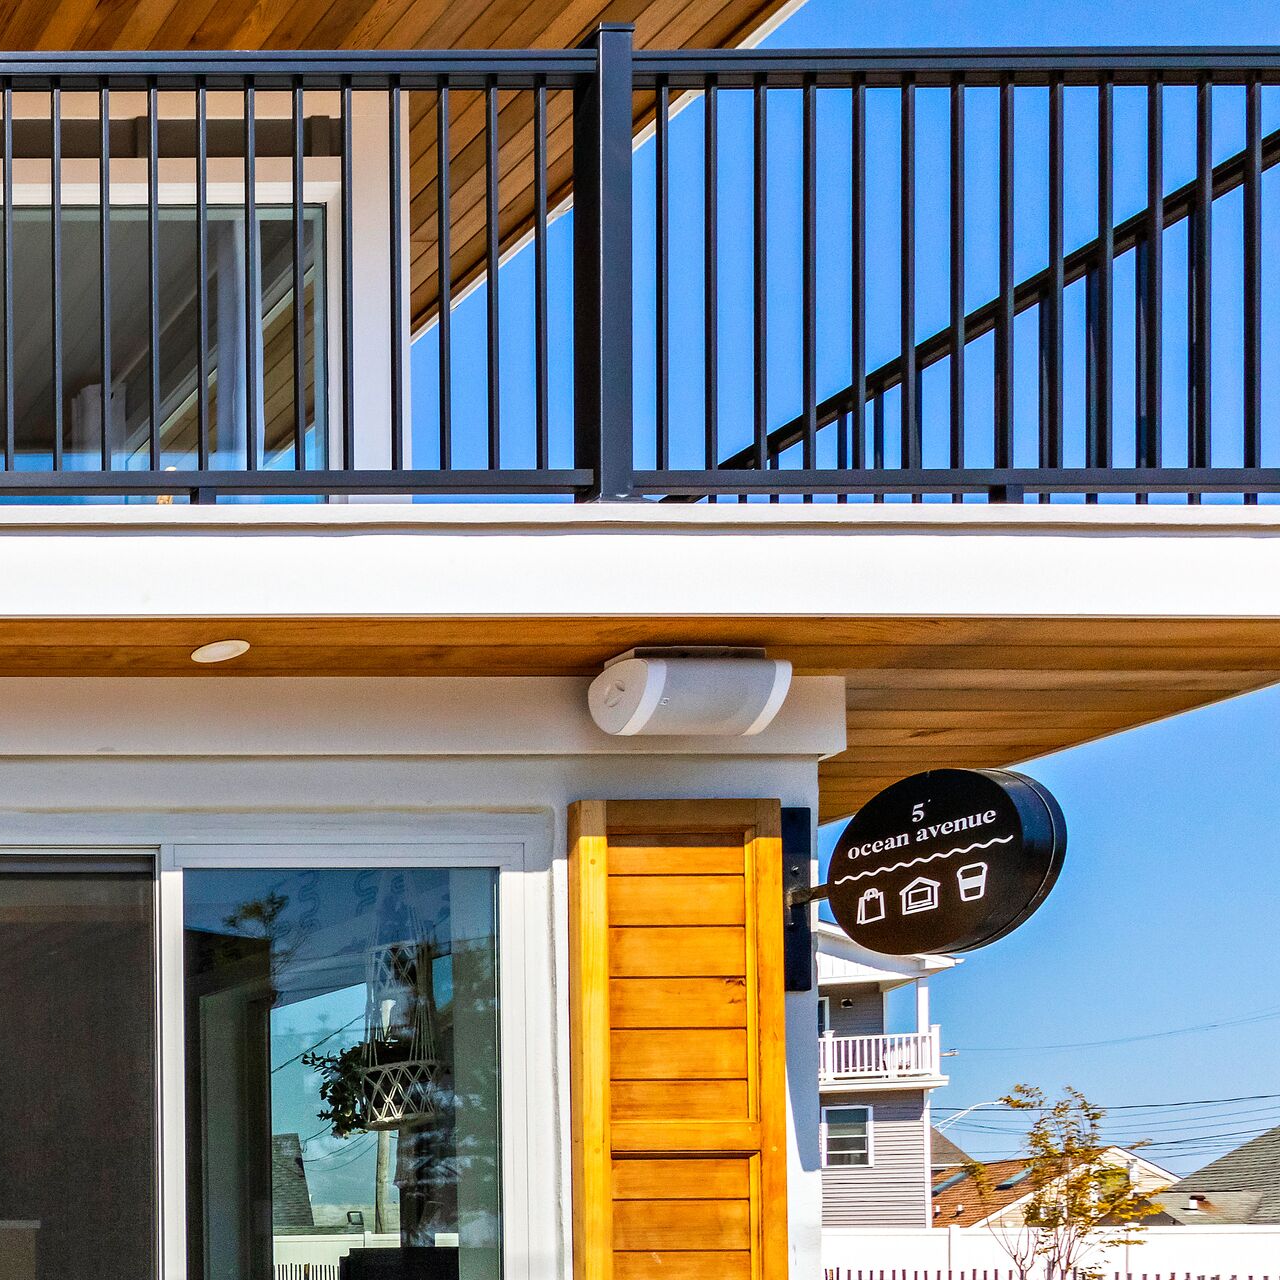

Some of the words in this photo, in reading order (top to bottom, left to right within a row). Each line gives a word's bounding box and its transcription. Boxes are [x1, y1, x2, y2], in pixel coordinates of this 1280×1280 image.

[911, 803, 925, 823] 5
[847, 833, 910, 860] ocean
[916, 809, 997, 843] avenue
